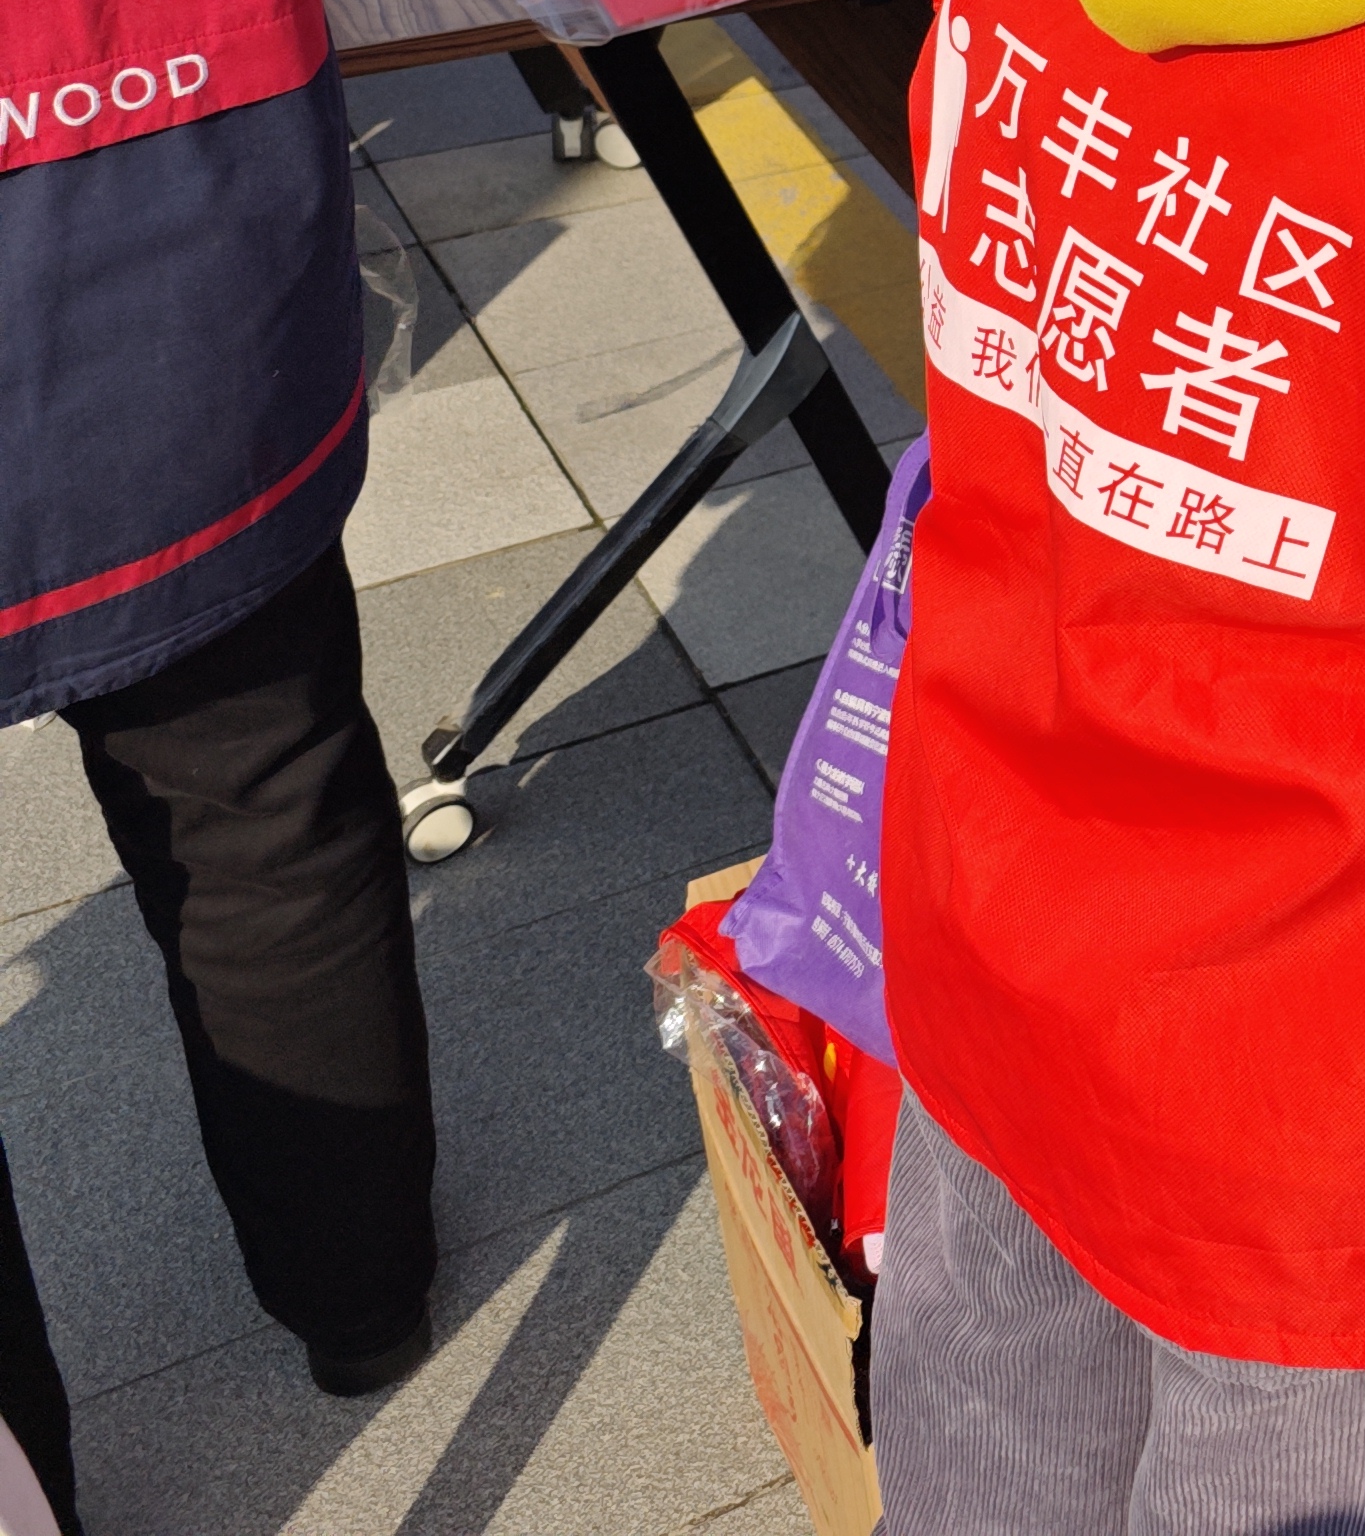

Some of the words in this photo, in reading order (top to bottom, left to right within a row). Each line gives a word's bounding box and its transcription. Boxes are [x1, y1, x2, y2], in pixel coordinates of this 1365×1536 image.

[968, 165, 1291, 462] 志愿者
[974, 22, 1354, 334] 万丰社区
